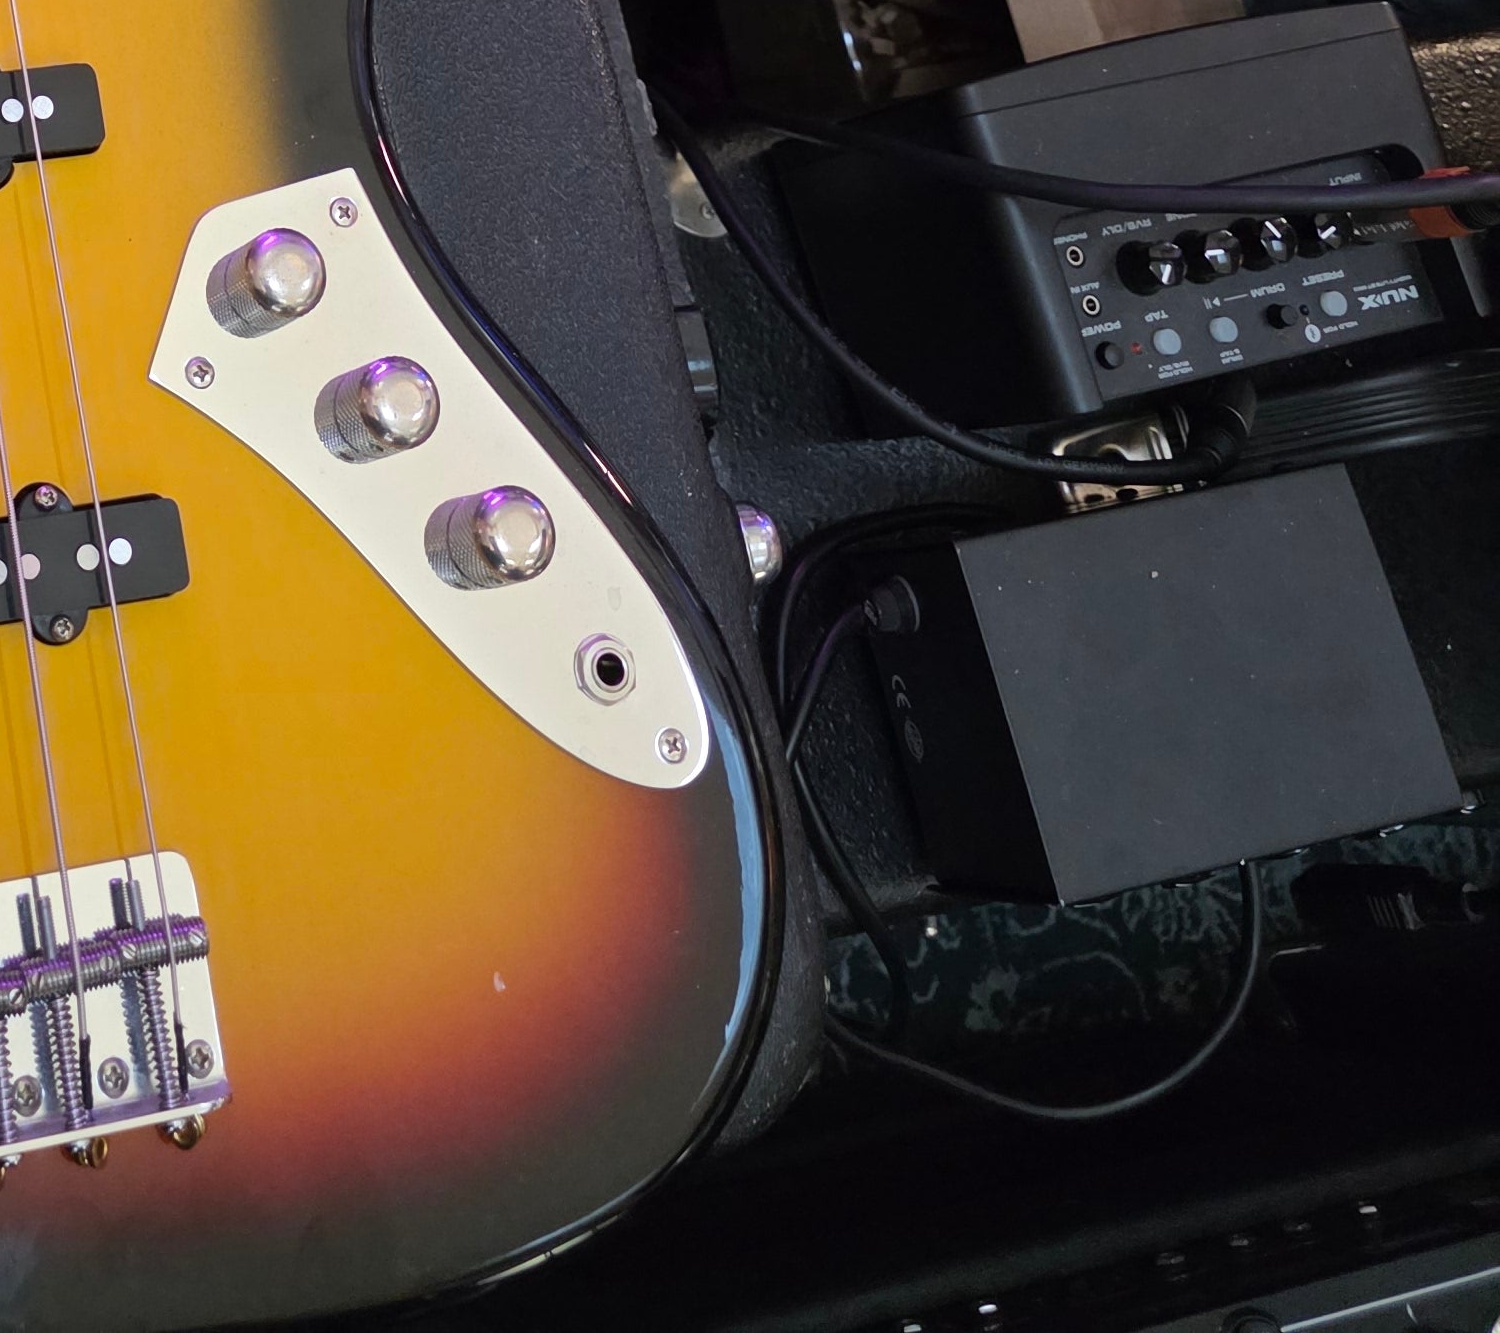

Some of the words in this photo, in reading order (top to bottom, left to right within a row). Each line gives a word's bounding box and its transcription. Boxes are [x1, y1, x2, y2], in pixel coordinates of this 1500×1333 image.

[1328, 172, 1362, 187] INPUT
[1302, 269, 1346, 287] PRESET
[1249, 283, 1286, 299] DRUM
[1356, 284, 1420, 311] NUX
[1144, 309, 1170, 323] TAP
[1081, 319, 1123, 338] POWER
